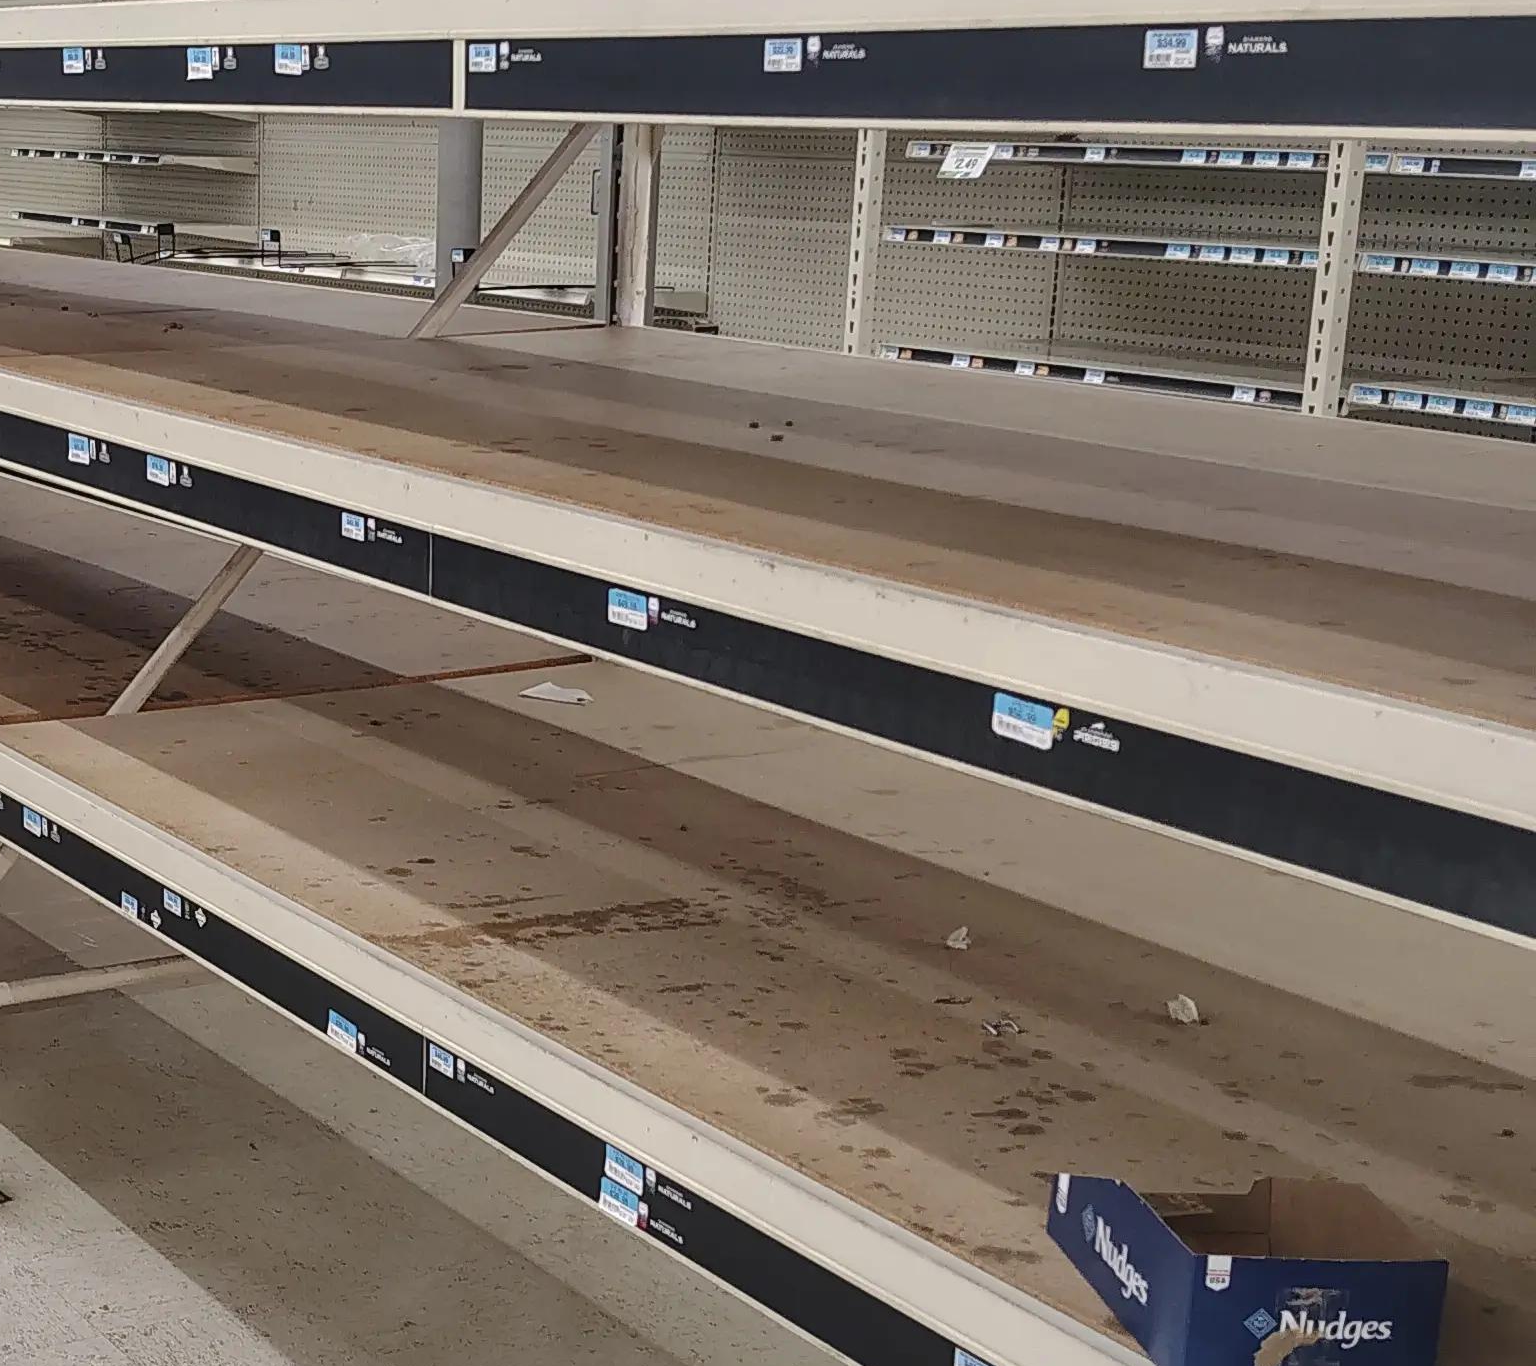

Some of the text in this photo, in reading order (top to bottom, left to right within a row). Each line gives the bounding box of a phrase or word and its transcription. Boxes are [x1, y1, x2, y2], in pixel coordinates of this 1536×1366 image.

[822, 48, 866, 59] NATURALS
[1227, 42, 1288, 54] NATURALS
[1095, 1215, 1149, 1306] Nudges
[1280, 1310, 1392, 1349] Nudges
